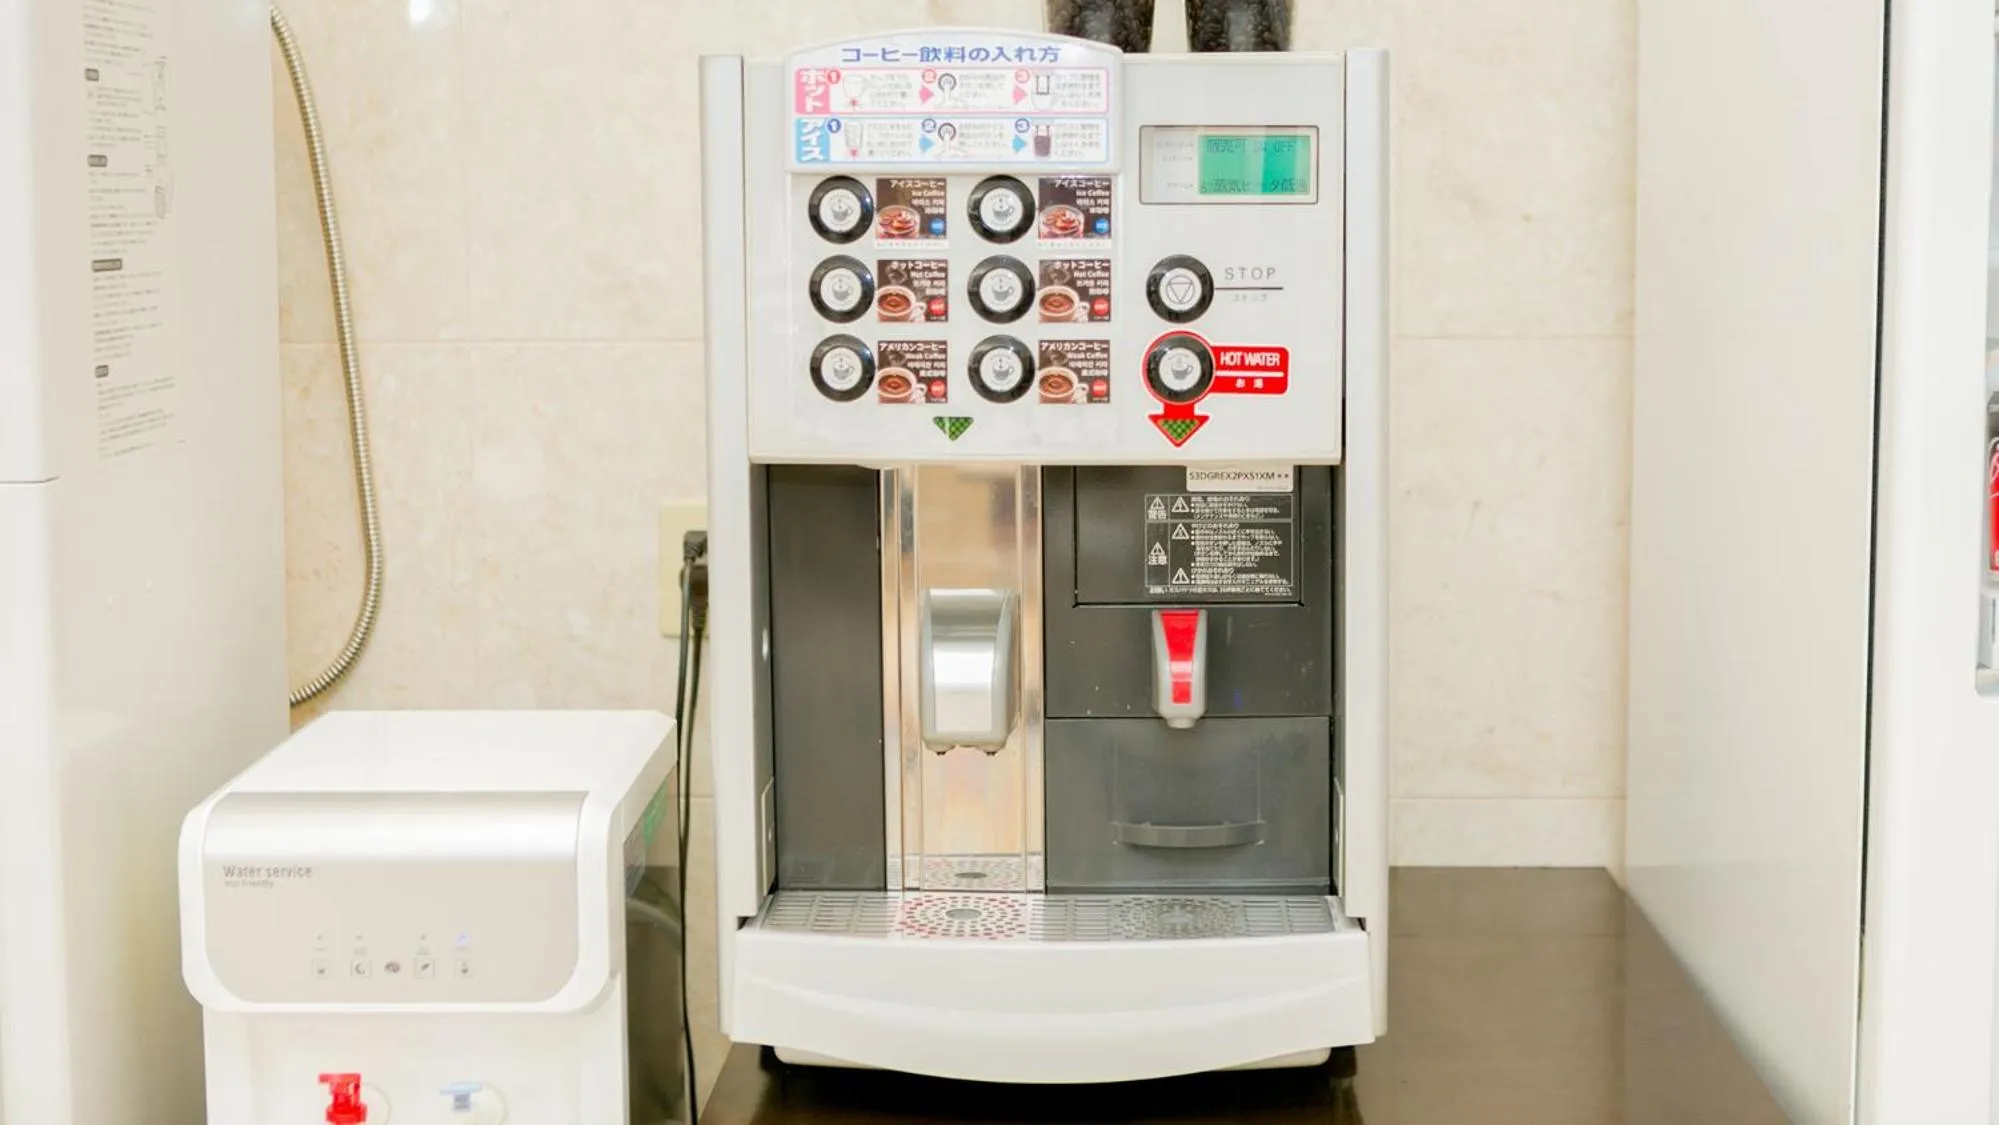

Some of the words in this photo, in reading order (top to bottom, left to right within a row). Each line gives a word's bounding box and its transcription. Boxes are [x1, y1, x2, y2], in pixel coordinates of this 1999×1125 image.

[842, 46, 1061, 63] コーヒー飲料の入れ方
[802, 70, 825, 112] ホット
[801, 119, 825, 161] アイス
[890, 180, 945, 188] アイスコーヒー
[1055, 180, 1110, 188] アイスコーヒー
[891, 261, 946, 269] ホットコーヒー
[1054, 261, 1109, 269] ホットコーヒー
[1224, 267, 1276, 281] STOP
[880, 343, 945, 352] アメリカンコーヒー
[1041, 342, 1108, 351] アメリカンコーヒー
[1220, 353, 1242, 365] HOT
[1244, 353, 1280, 366] WATER
[1149, 556, 1167, 565] 注意
[222, 865, 262, 878] Water
[265, 865, 312, 878] service
